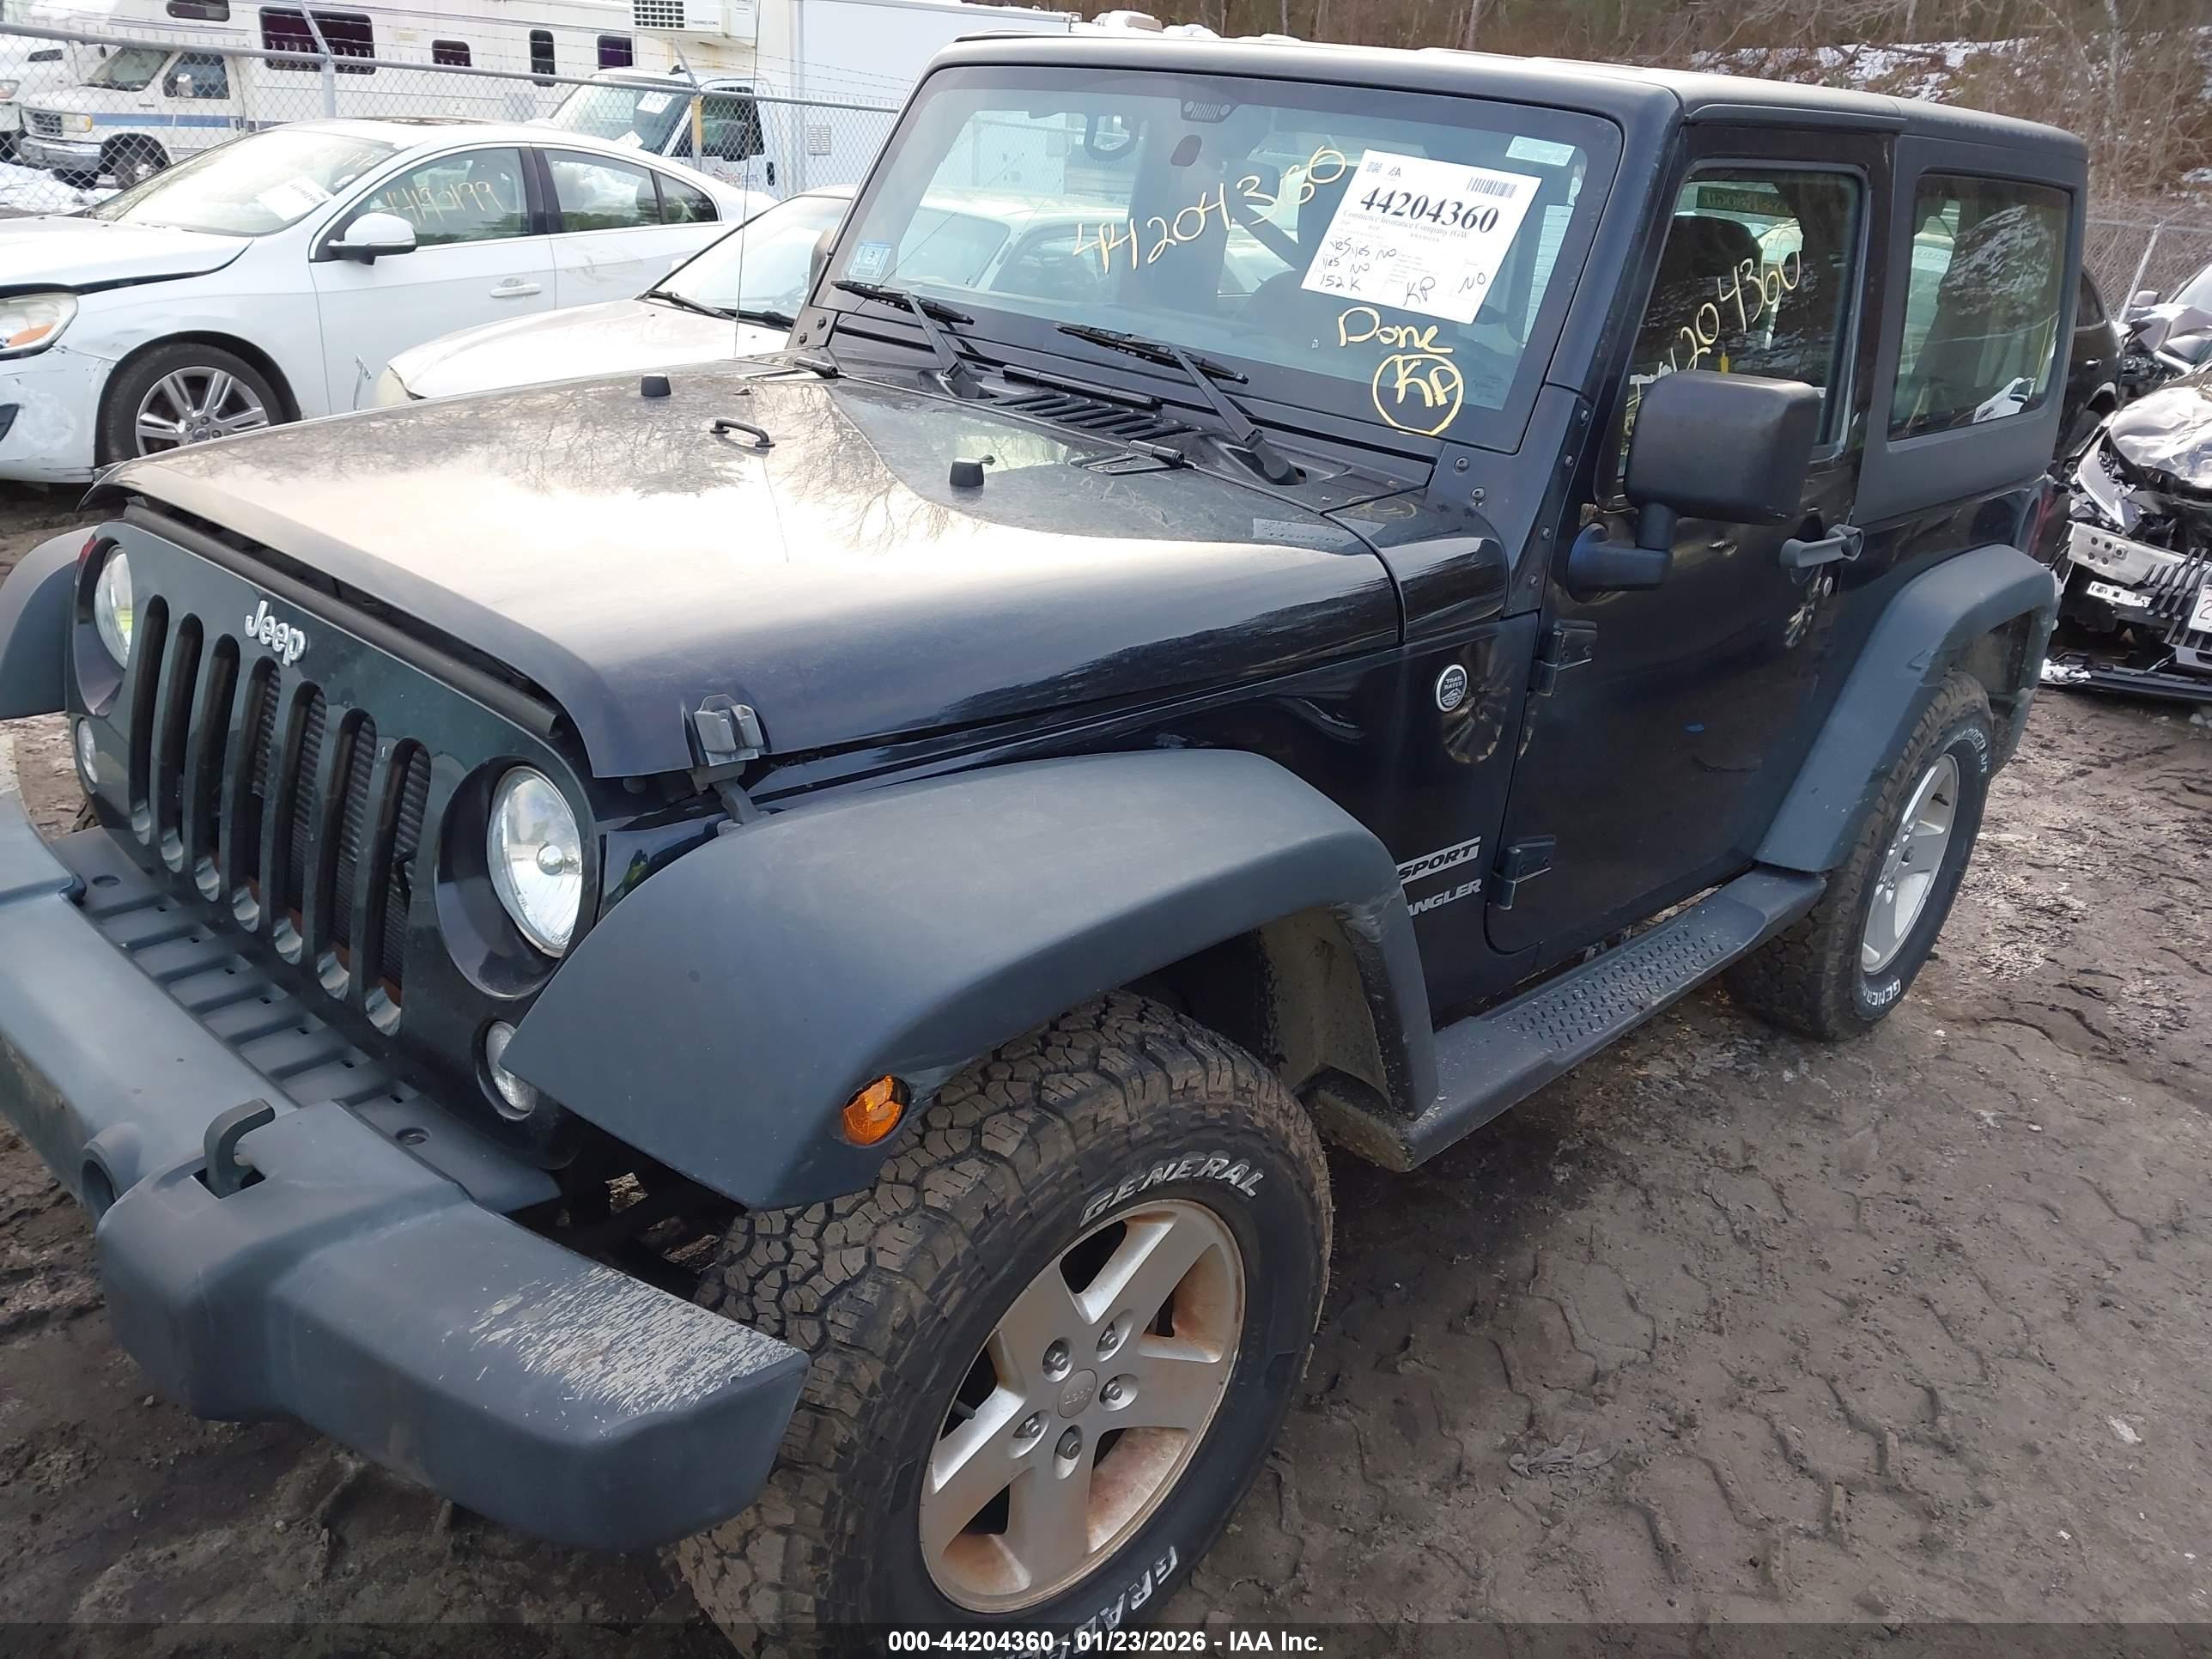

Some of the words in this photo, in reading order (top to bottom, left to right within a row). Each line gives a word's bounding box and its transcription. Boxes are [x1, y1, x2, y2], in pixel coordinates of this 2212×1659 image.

[1073, 144, 1346, 274] 44204360
[1360, 186, 1499, 234] 44204360
[1338, 306, 1453, 354] Done
[245, 600, 307, 667] Jeep
[1398, 844, 1479, 880] SPORT
[1079, 1155, 1264, 1229] GENERAL
